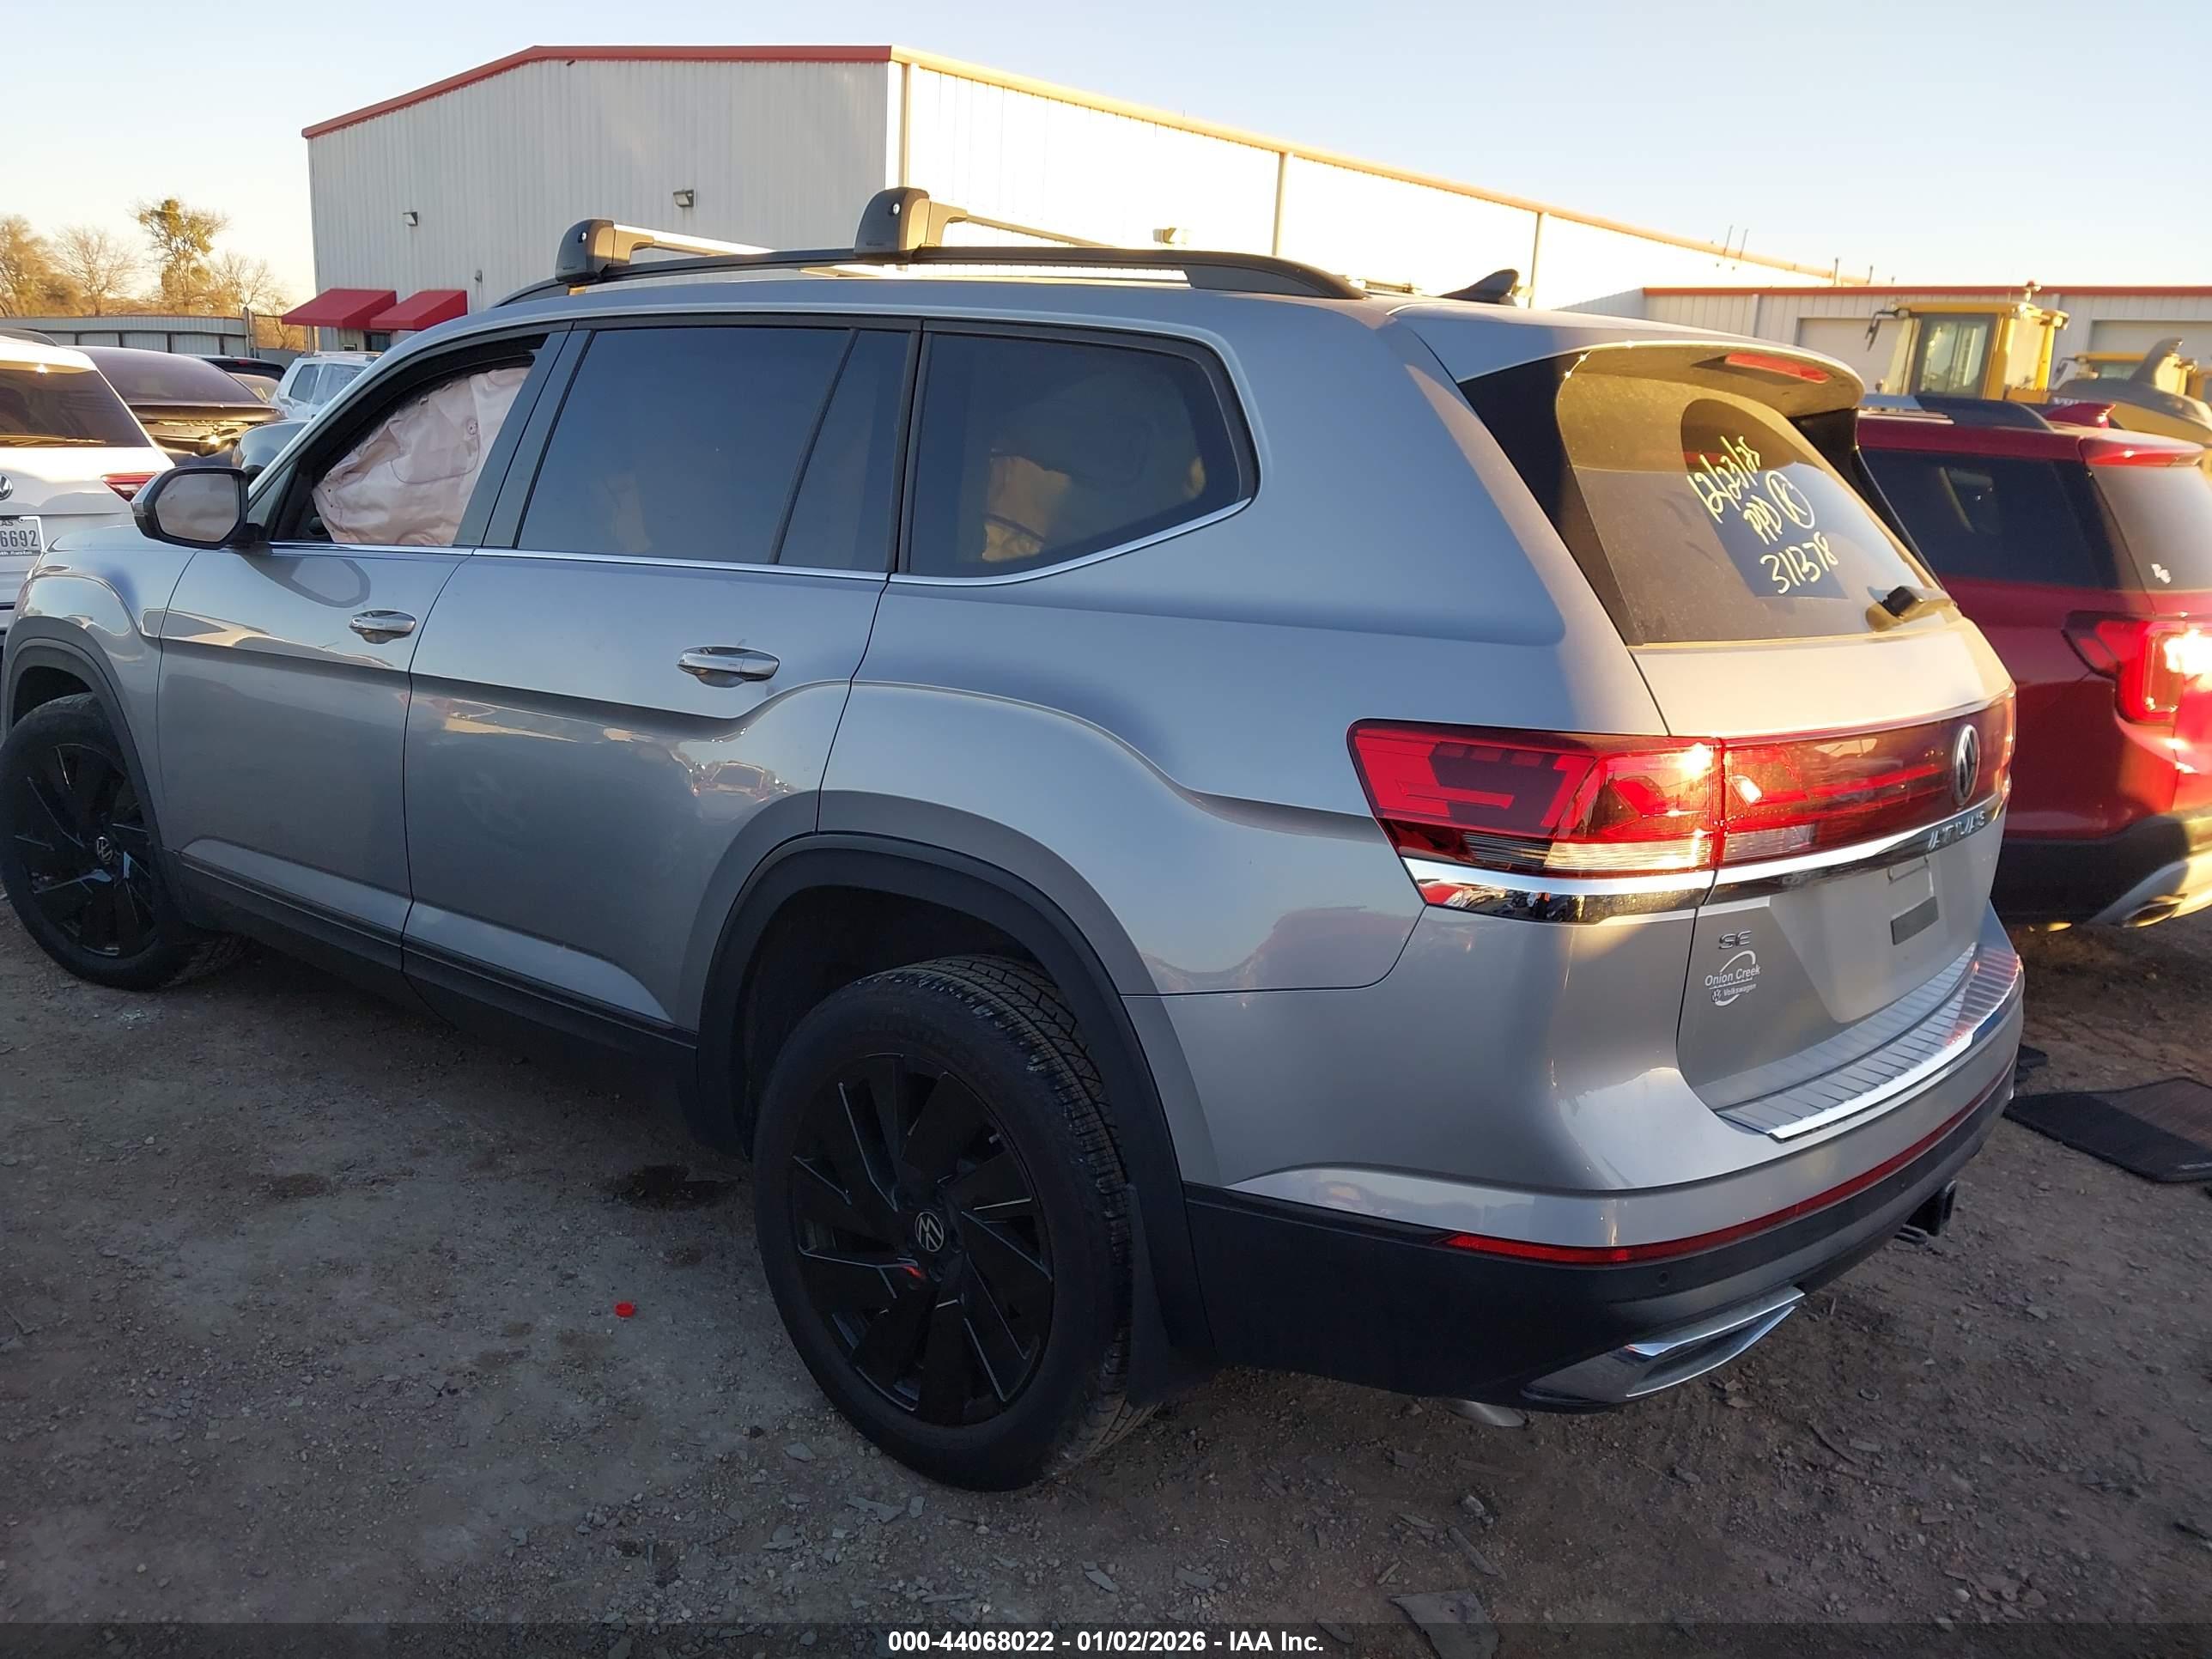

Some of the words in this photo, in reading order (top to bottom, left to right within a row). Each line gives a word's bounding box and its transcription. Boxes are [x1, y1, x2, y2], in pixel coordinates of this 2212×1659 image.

[1759, 531, 1838, 594] 311378
[1718, 930, 1752, 950] SE
[1705, 972, 1733, 987] Onion
[1735, 963, 1760, 980] Creek
